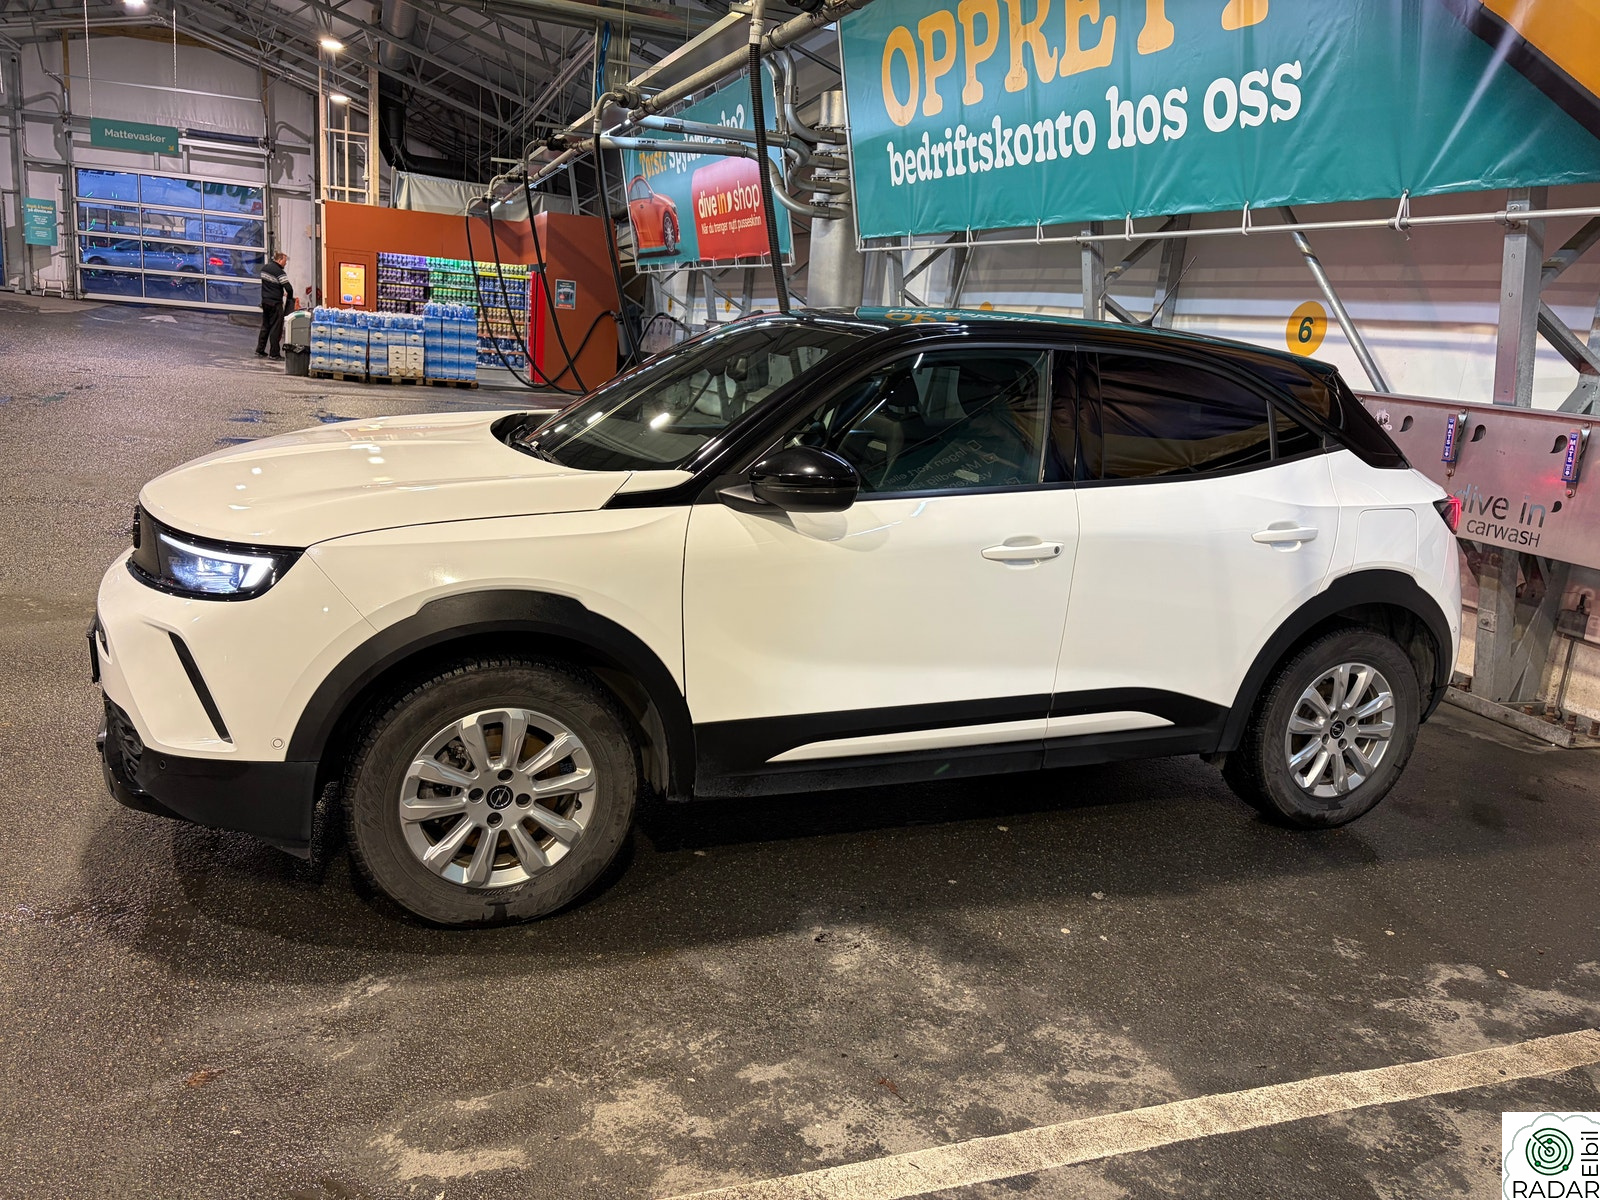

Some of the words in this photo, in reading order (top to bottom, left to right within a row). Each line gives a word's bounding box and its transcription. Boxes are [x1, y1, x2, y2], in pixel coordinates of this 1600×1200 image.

[881, 0, 1269, 127] OPPRET
[104, 128, 166, 143] Mattevasker
[886, 109, 1097, 187] bedriftskonto
[1105, 85, 1188, 151] hos
[1202, 59, 1302, 133] oss
[733, 180, 760, 213] shop
[709, 222, 715, 234] du
[714, 222, 728, 235] trenger
[728, 219, 738, 234] nytt
[737, 213, 762, 232] pusseskinn
[1298, 316, 1314, 344] 6
[1446, 423, 1454, 445] MATS
[1567, 439, 1576, 463] MATS
[1454, 483, 1510, 520] dive
[1518, 495, 1546, 528] in
